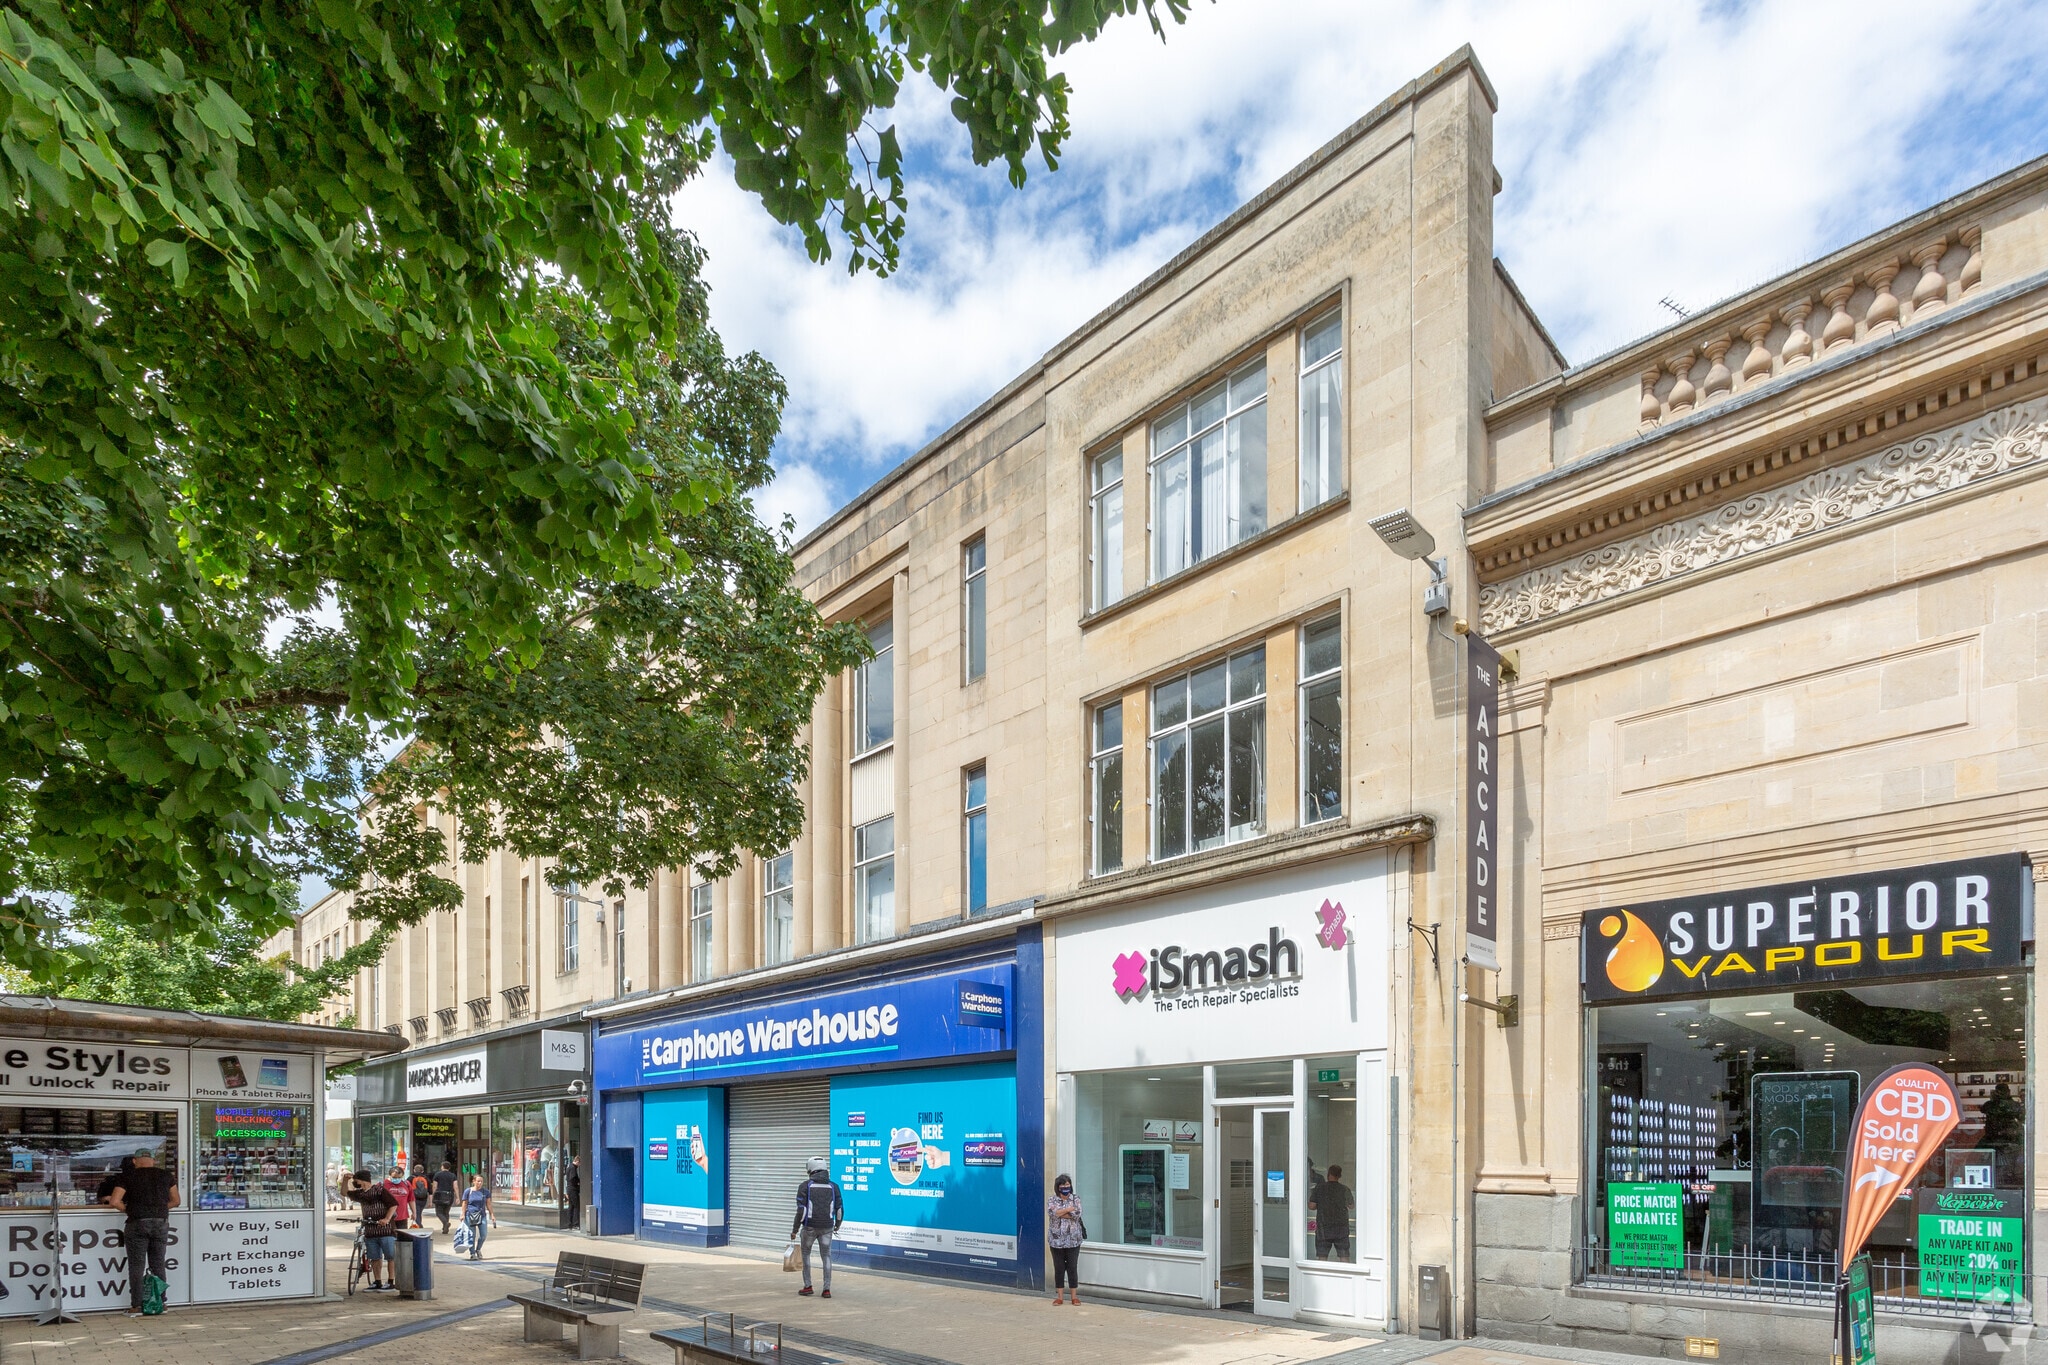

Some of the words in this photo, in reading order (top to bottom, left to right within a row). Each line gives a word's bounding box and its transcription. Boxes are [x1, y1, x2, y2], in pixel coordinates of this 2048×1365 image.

[1476, 665, 1491, 687] THE
[1476, 705, 1490, 927] ARCADE
[1669, 874, 1990, 956] SUPERIOR
[1323, 910, 1344, 941] iSmash
[1150, 927, 1299, 991] iSmash
[1671, 928, 1992, 979] VAPOUR
[965, 992, 1003, 1005] Carphone
[1154, 1001, 1173, 1013] The
[1175, 998, 1199, 1010] Tech
[1202, 993, 1236, 1008] Repair
[1239, 984, 1299, 1004] Specialists
[961, 1002, 1003, 1014] Warehouse
[642, 1039, 650, 1069] THE
[651, 1029, 745, 1068] Carphone
[747, 1004, 899, 1053] Warehouse
[551, 1043, 576, 1054] M&S
[46, 1047, 171, 1077] Styles
[29, 1075, 95, 1089] Unlock
[112, 1079, 170, 1093] Repair
[1764, 1085, 1790, 1093] POD
[1895, 1078, 1939, 1090] QUALITY
[196, 1088, 228, 1096] Phone
[275, 1091, 312, 1099] Repairs
[1764, 1094, 1800, 1104] MODS
[1875, 1088, 1952, 1122] CBD
[215, 1108, 253, 1116] MOBILE
[257, 1109, 291, 1117] PHONE
[215, 1115, 273, 1123] UNLOCKING
[918, 1112, 932, 1123] FIND
[934, 1111, 943, 1123] US
[216, 1129, 287, 1138] ACCESSORIES
[921, 1124, 944, 1140] HERE
[1863, 1119, 1918, 1143] Sold
[965, 1145, 980, 1153] Currys
[1863, 1140, 1917, 1164] here
[676, 1160, 692, 1174] HERE
[1614, 1195, 1641, 1208] PRICE
[1643, 1195, 1677, 1209] MATCH
[1614, 1211, 1678, 1226] GUARANTEE
[209, 1222, 234, 1232] We
[239, 1221, 270, 1232] Buy,
[274, 1220, 300, 1230] Sell
[1938, 1219, 1983, 1236] TRADE
[1987, 1221, 2003, 1237] IN
[9, 1225, 179, 1255] Repas
[242, 1235, 269, 1245] and
[1633, 1233, 1648, 1241] PRICE
[1928, 1238, 1946, 1248] ANY
[1949, 1239, 1973, 1250] VAPE
[1975, 1240, 1991, 1251] KIT
[1993, 1241, 2013, 1252] AND
[202, 1252, 232, 1261] Part
[237, 1250, 306, 1260] Exchange
[1924, 1253, 1965, 1267] RECEIVE
[1968, 1252, 1999, 1270] 20%
[221, 1266, 274, 1275] Phones
[278, 1263, 288, 1273] &
[229, 1279, 282, 1289] Tablets
[1926, 1271, 1945, 1283] ANY
[1948, 1273, 1969, 1285] NEW
